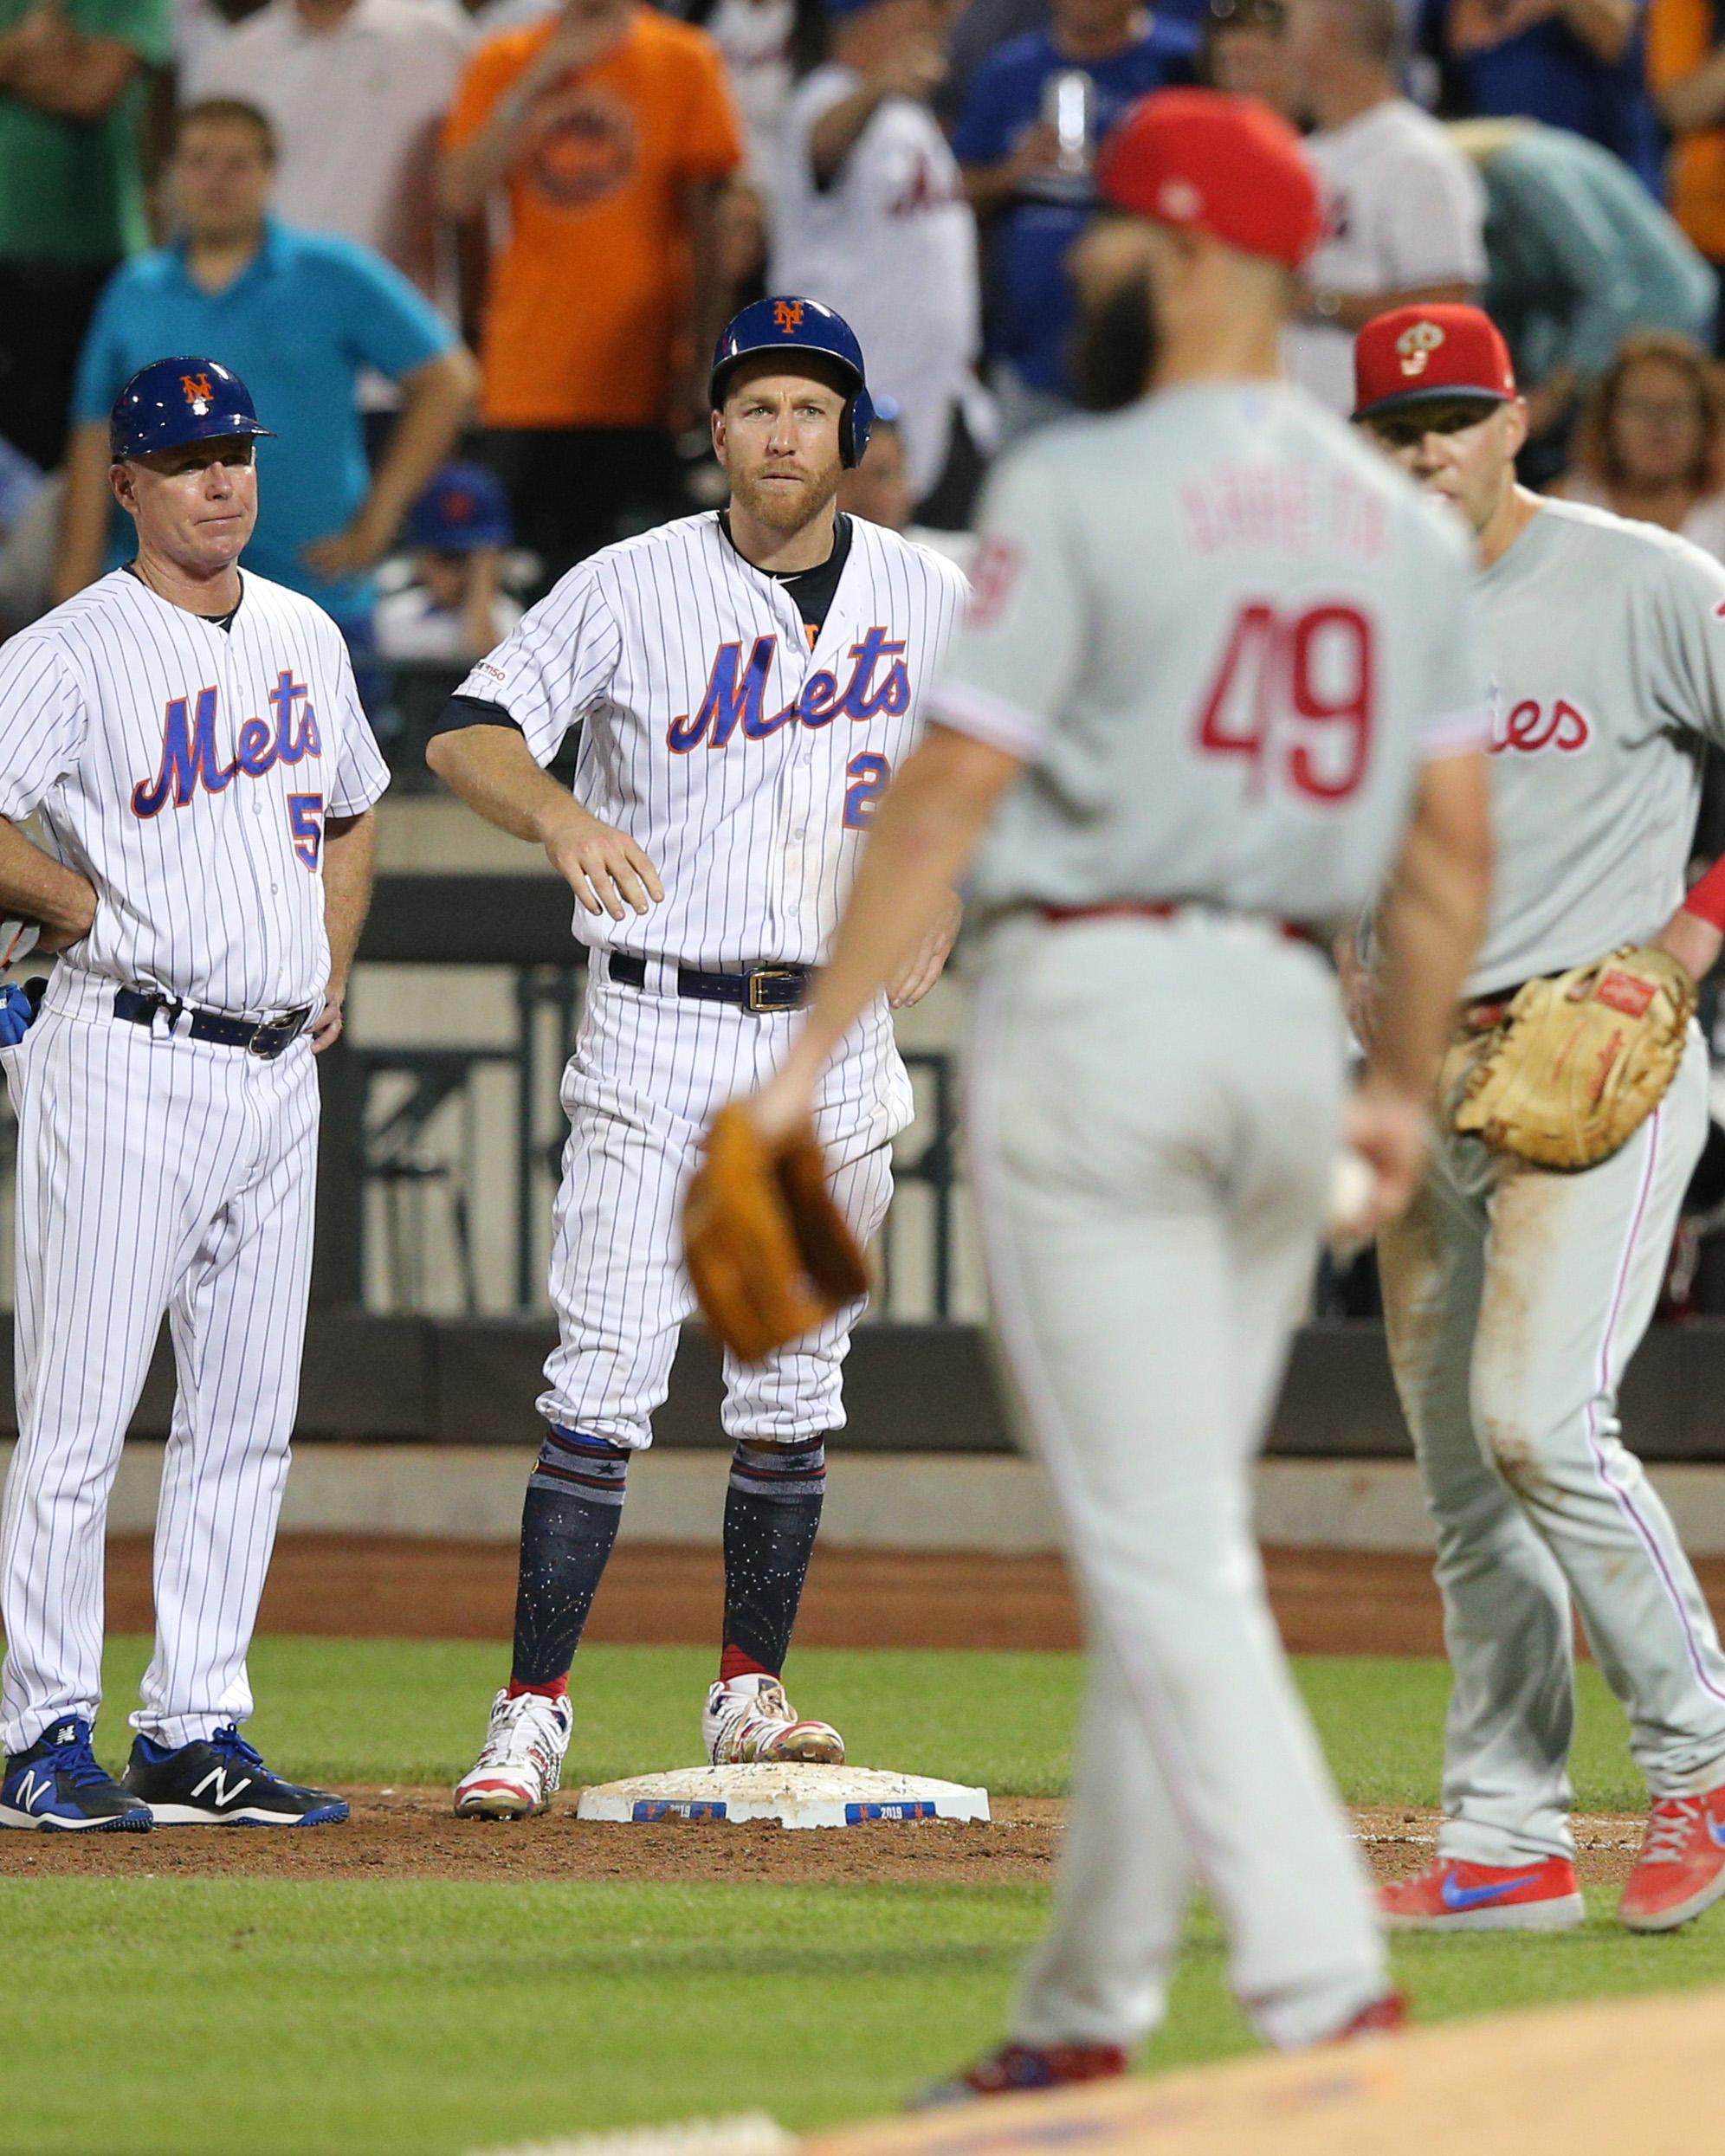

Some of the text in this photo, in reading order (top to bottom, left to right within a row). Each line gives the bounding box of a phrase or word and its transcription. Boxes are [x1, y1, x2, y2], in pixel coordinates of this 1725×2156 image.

[130, 669, 322, 819] Mets
[666, 626, 912, 755] Mets
[1199, 602, 1375, 805] 49
[287, 792, 324, 874] 5
[880, 1806, 903, 1820] 2019
